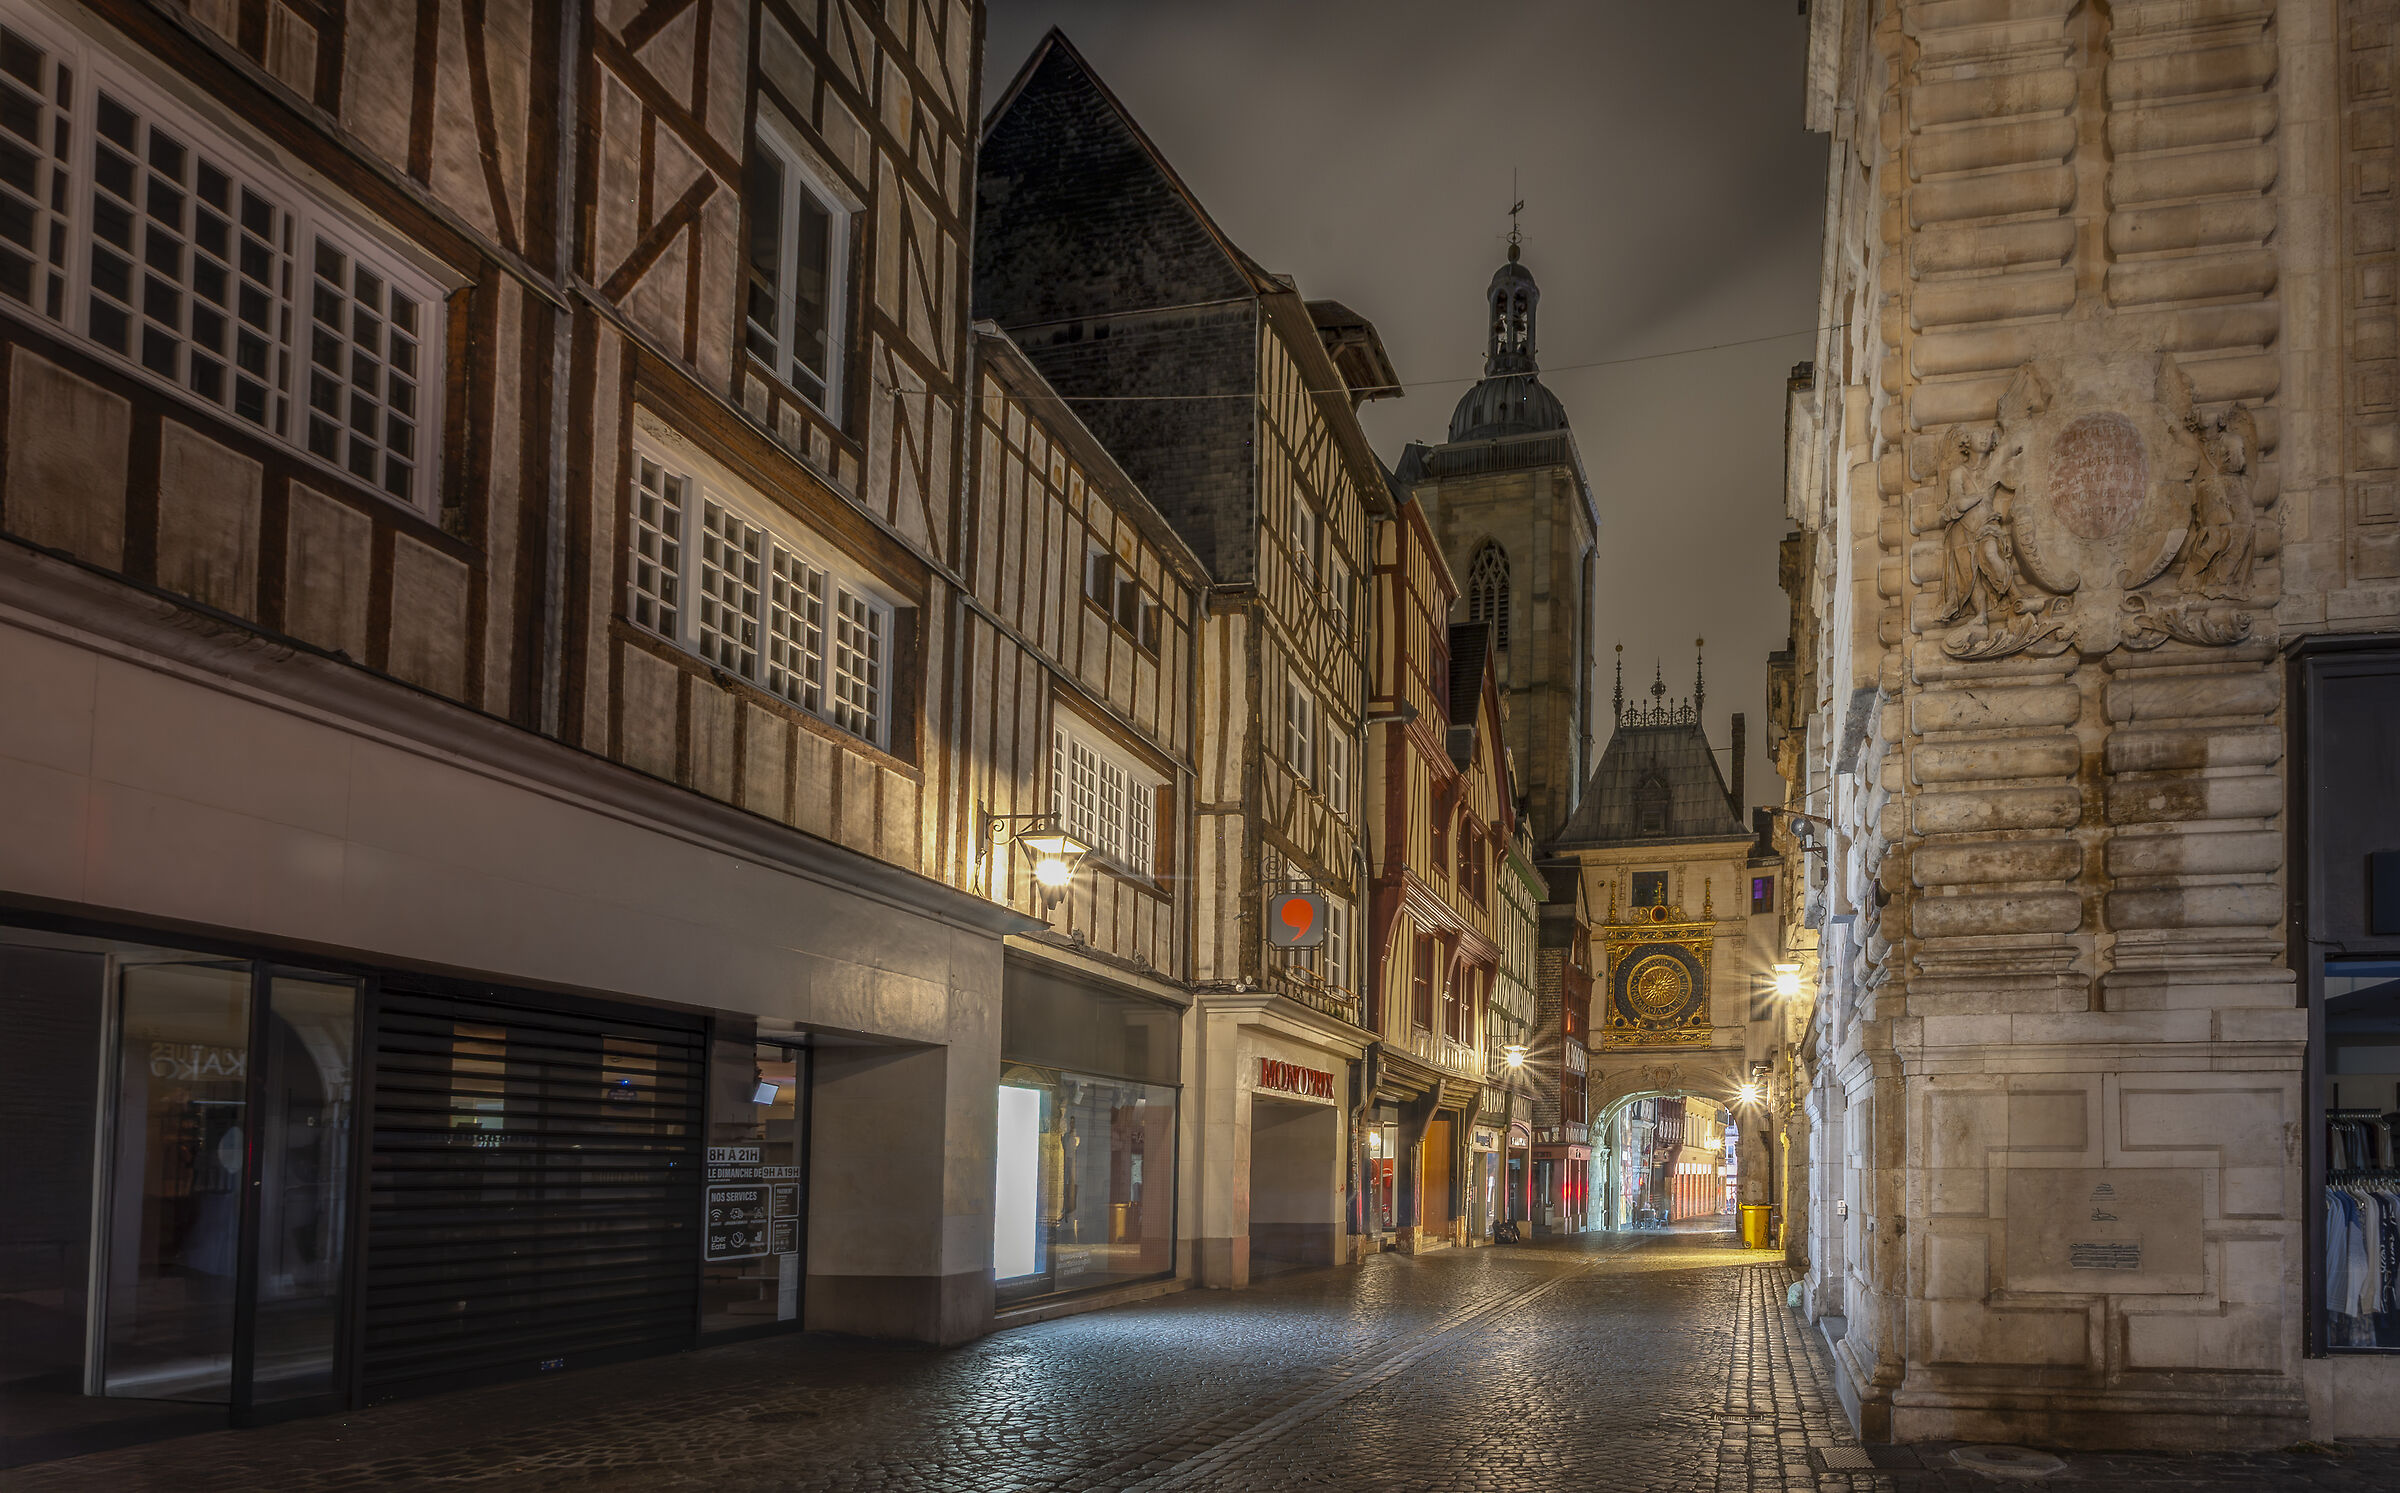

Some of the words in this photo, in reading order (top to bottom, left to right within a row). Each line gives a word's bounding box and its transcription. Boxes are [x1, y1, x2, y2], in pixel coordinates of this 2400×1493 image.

[1260, 1057, 1335, 1099] MONOPRIX
[709, 1149, 725, 1161] 8H
[738, 1149, 758, 1161] 21H
[708, 1168, 717, 1178] LE
[717, 1168, 753, 1178] DIMANCHE
[753, 1168, 763, 1178] DE
[763, 1167, 775, 1177] 9H
[784, 1167, 799, 1177] 19H
[711, 1192, 725, 1203] NOS
[726, 1191, 758, 1202] SERVICES
[711, 1235, 727, 1243] Uber
[711, 1242, 726, 1250] Eats
